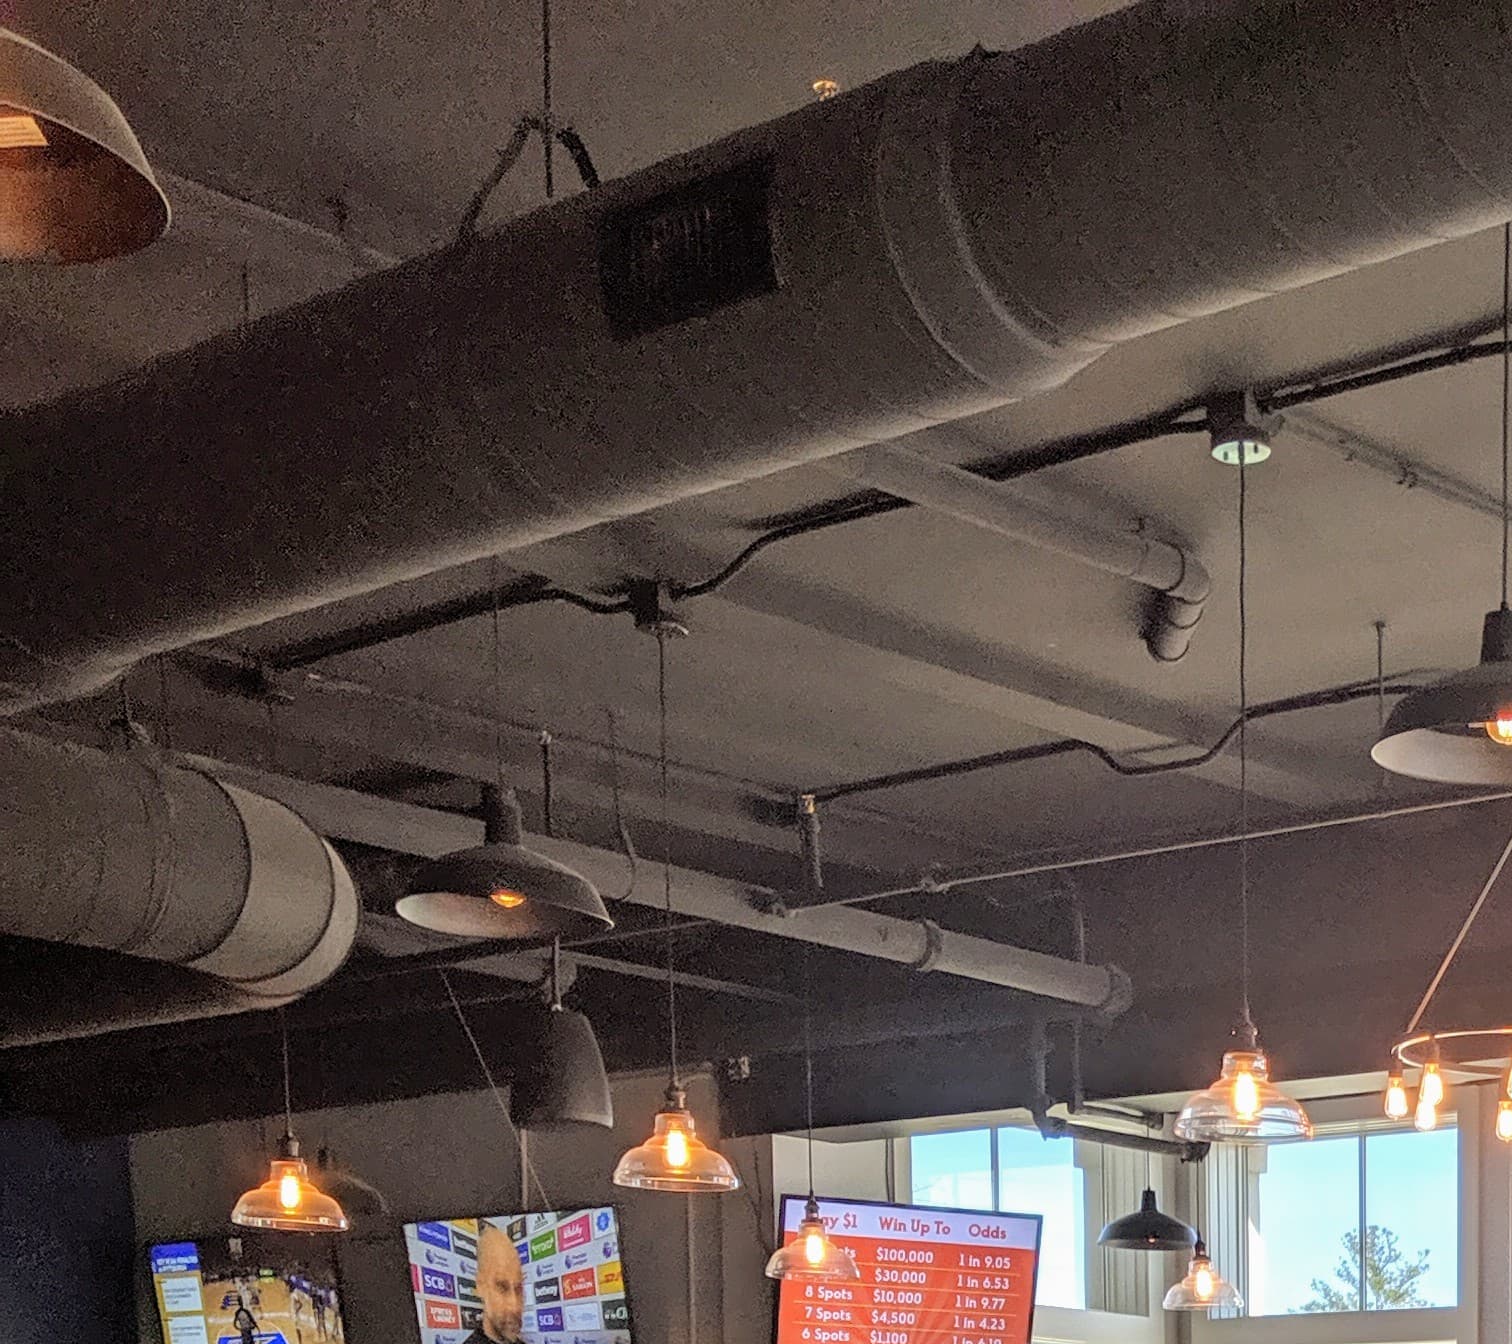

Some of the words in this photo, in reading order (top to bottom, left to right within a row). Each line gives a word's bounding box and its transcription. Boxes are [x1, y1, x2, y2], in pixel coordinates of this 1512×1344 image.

[843, 1215, 857, 1229] $1
[879, 1216, 906, 1232] Win
[911, 1218, 930, 1235] Up
[935, 1220, 951, 1235] To
[968, 1223, 1007, 1240] Odds
[876, 1246, 934, 1264] $100,000
[958, 1253, 965, 1267] 1
[968, 1254, 981, 1268] in
[984, 1255, 1011, 1270] 9.05
[424, 1274, 446, 1291] SCB
[874, 1268, 926, 1285] $30,000
[957, 1274, 963, 1288] 1
[966, 1275, 979, 1289] in
[982, 1276, 1010, 1290] 6.53
[805, 1285, 813, 1298] 8
[817, 1286, 852, 1302] Spots
[873, 1289, 922, 1305] $10,000
[955, 1295, 961, 1308] 1
[964, 1295, 978, 1309] in
[980, 1297, 1006, 1311] 9.77
[538, 1313, 554, 1326] SCB
[804, 1306, 812, 1318] 7
[816, 1306, 851, 1322] Spots
[871, 1310, 916, 1325] $4,500
[953, 1315, 960, 1328] 1
[963, 1316, 976, 1329] in
[979, 1317, 1006, 1331] 4.23
[801, 1327, 810, 1340] 6
[814, 1328, 850, 1344] Spots
